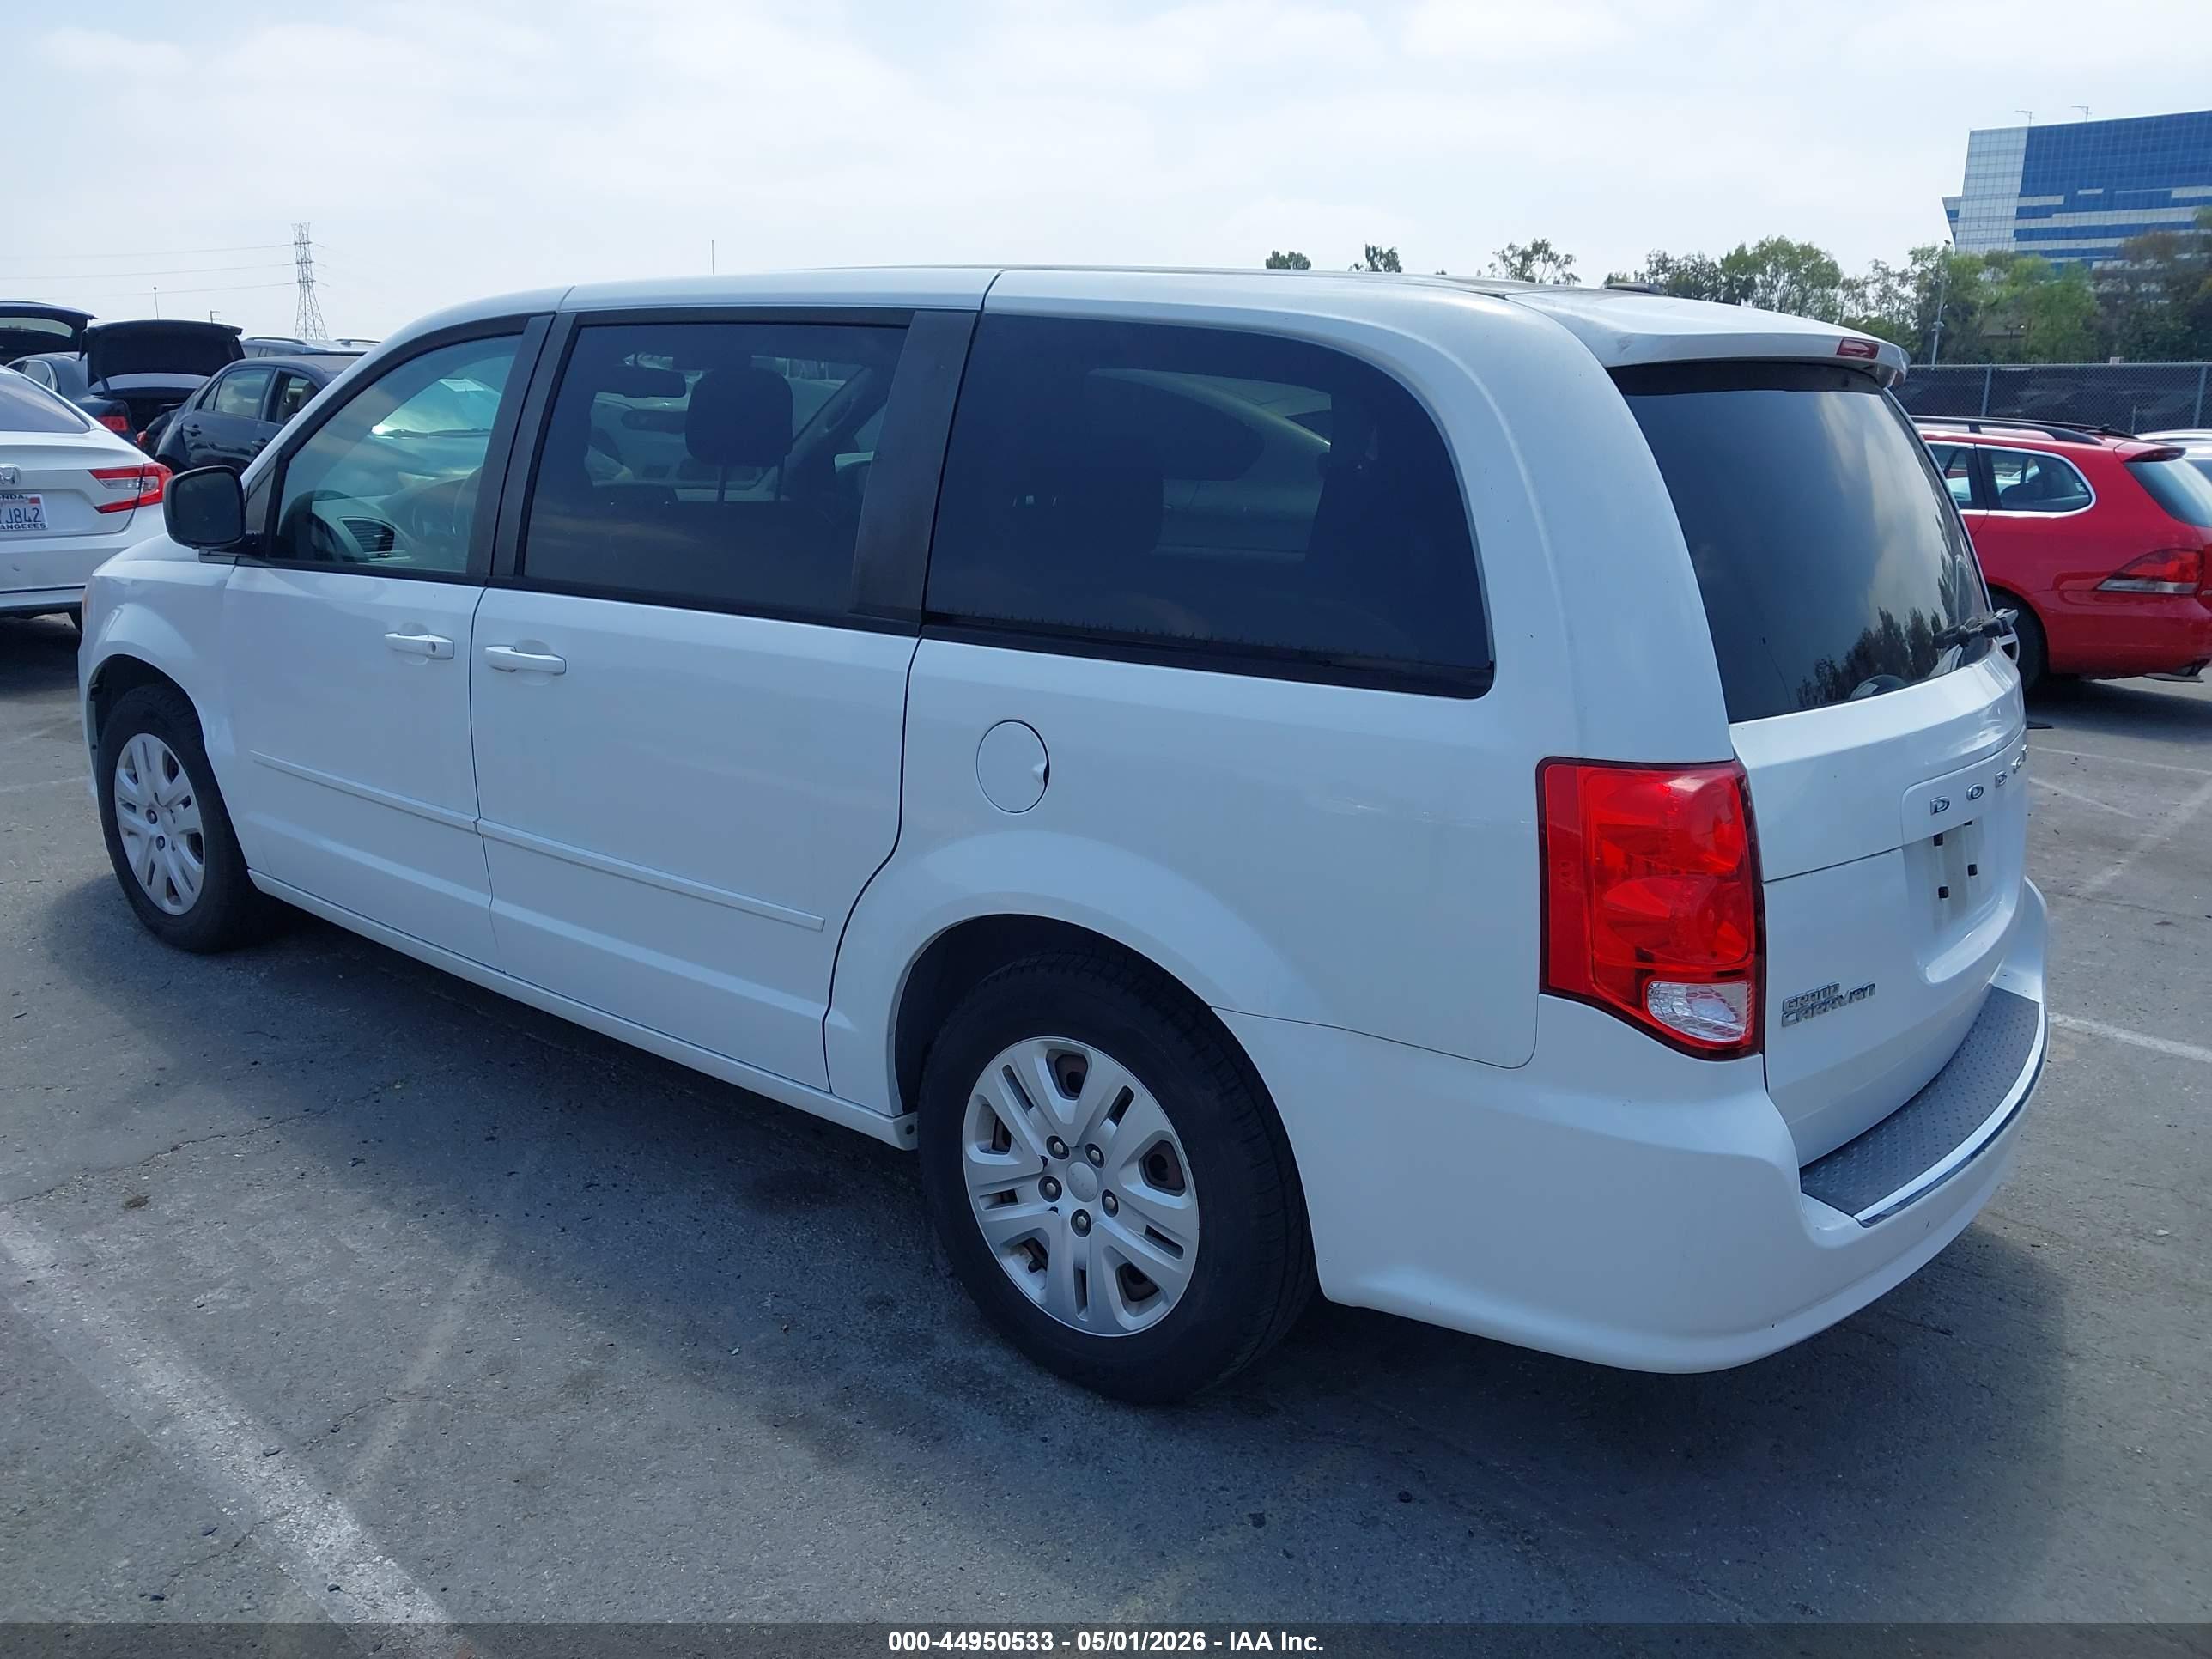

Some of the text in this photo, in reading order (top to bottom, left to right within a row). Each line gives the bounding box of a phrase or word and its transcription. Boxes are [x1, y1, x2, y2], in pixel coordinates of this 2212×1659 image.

[0, 507, 42, 524] J842
[1781, 981, 1876, 1028] CARAVAN
[1782, 981, 1841, 1012] GRAND
